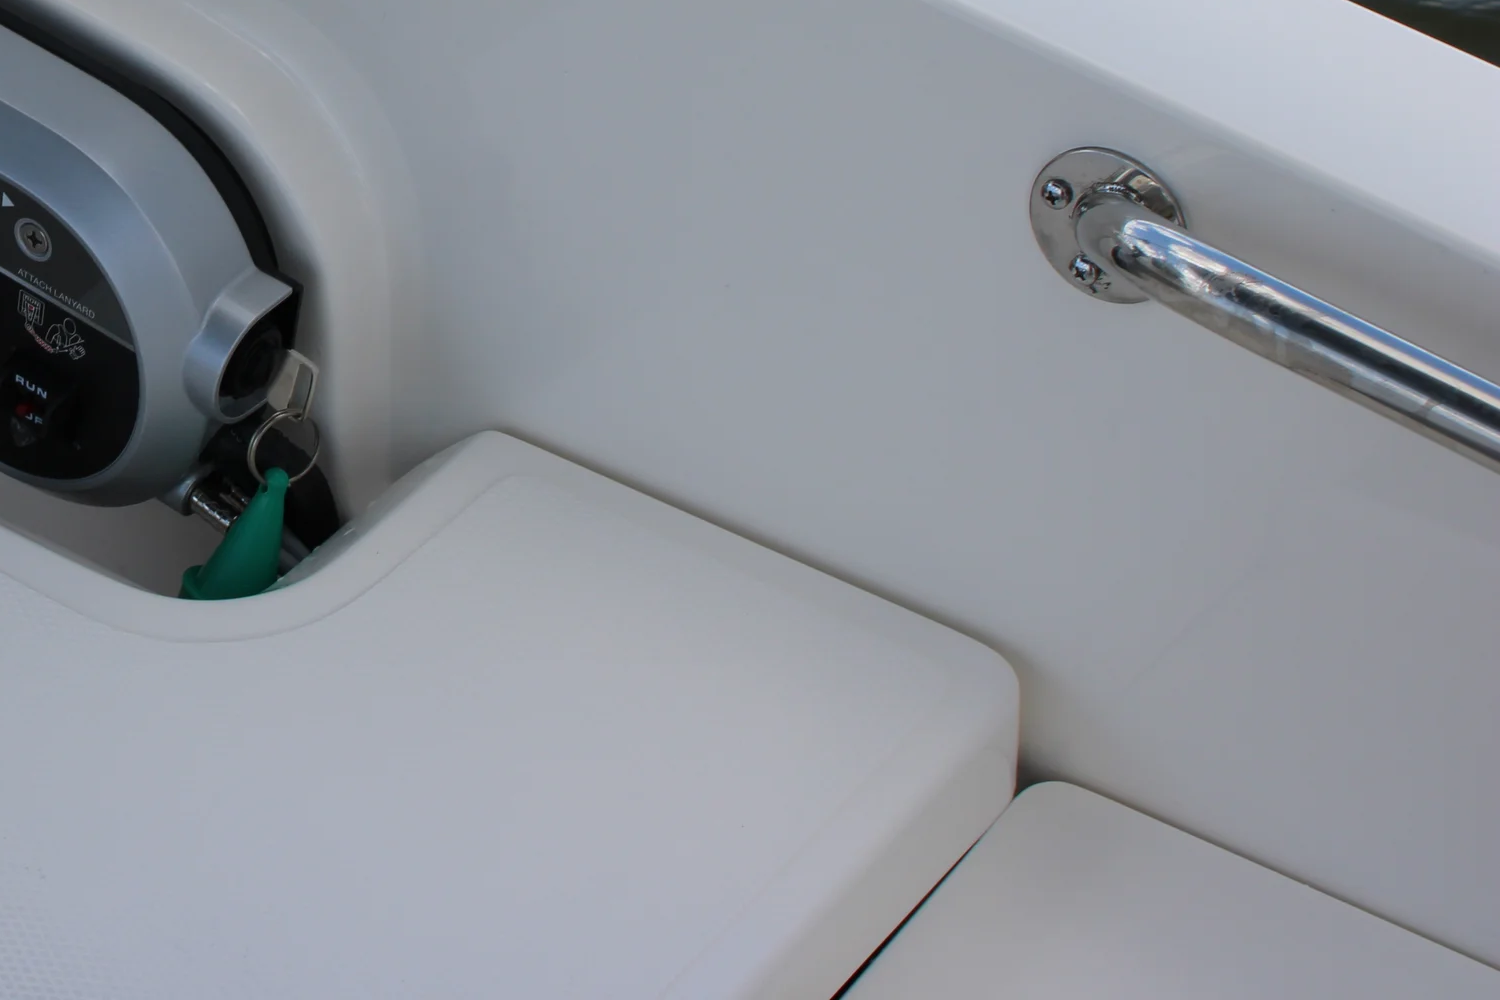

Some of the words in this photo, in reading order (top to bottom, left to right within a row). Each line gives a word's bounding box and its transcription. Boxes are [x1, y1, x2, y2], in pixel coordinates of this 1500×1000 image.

[17, 268, 52, 293] ATTACH
[53, 289, 96, 319] LANYARD
[15, 374, 47, 399] RUN
